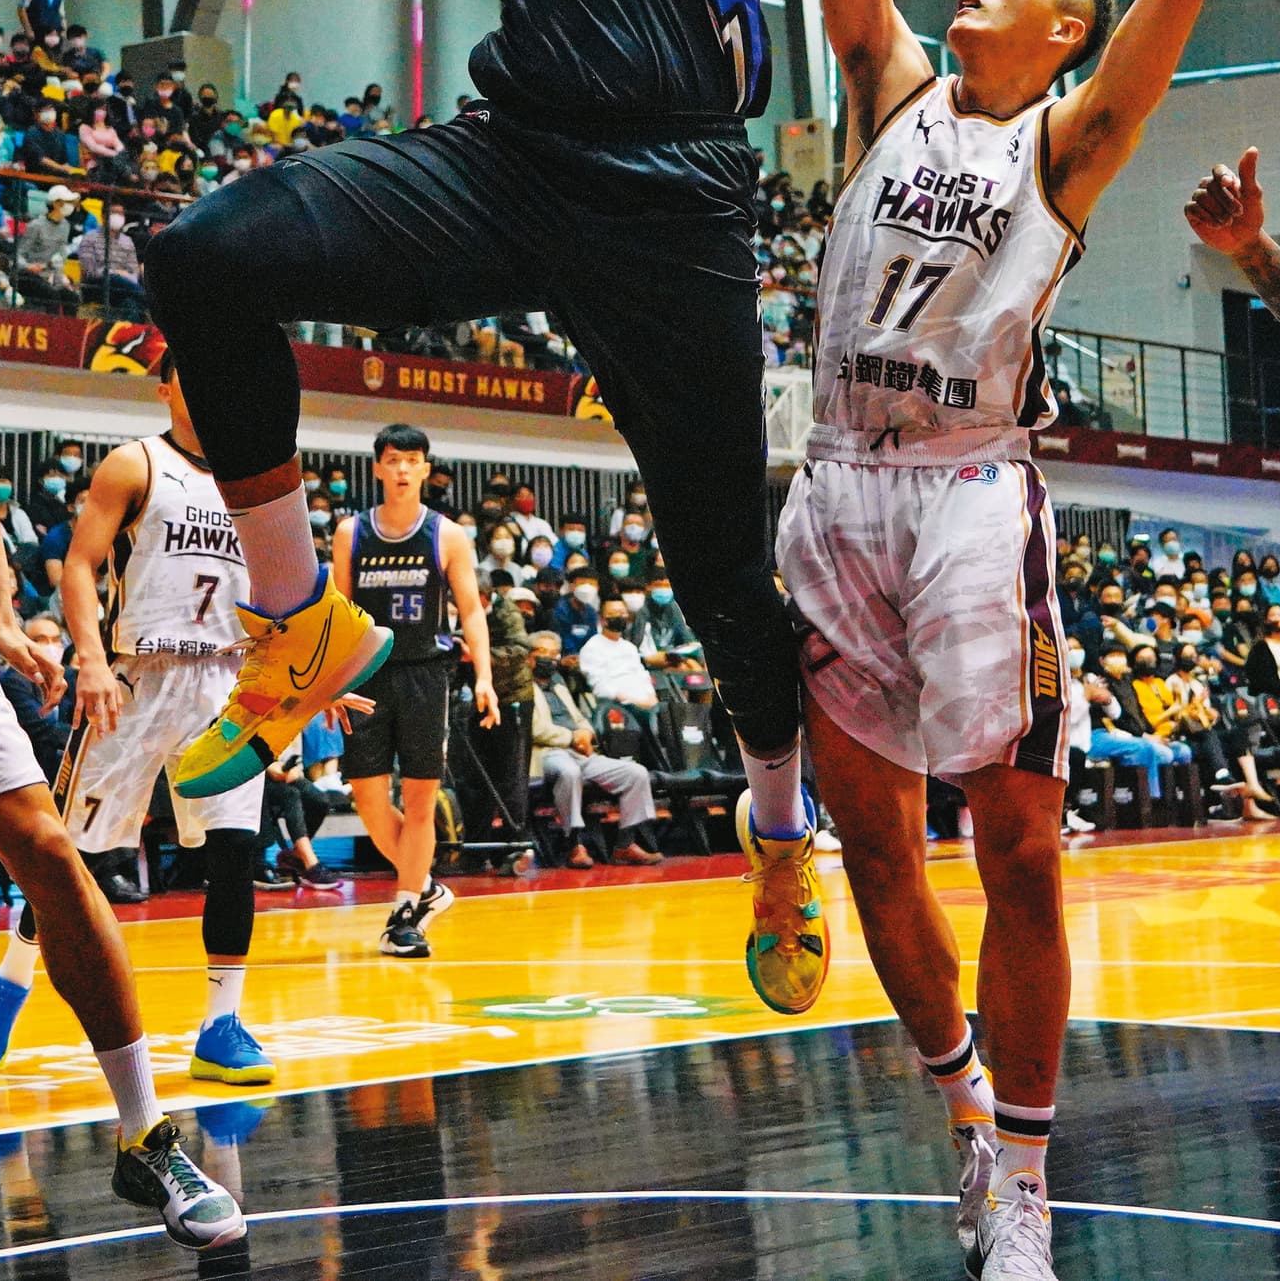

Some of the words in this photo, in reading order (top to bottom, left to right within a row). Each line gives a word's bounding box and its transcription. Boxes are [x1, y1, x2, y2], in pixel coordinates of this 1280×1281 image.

[912, 166, 1001, 200] GHST
[874, 176, 1013, 256] HAWKS
[866, 254, 956, 333] 17
[398, 367, 468, 395] GHOST
[476, 375, 545, 403] HAWKS
[186, 505, 233, 528] GHOS
[163, 519, 242, 557] HAWK
[191, 573, 220, 626] 7
[391, 593, 423, 621] 25
[84, 795, 103, 833] 7
